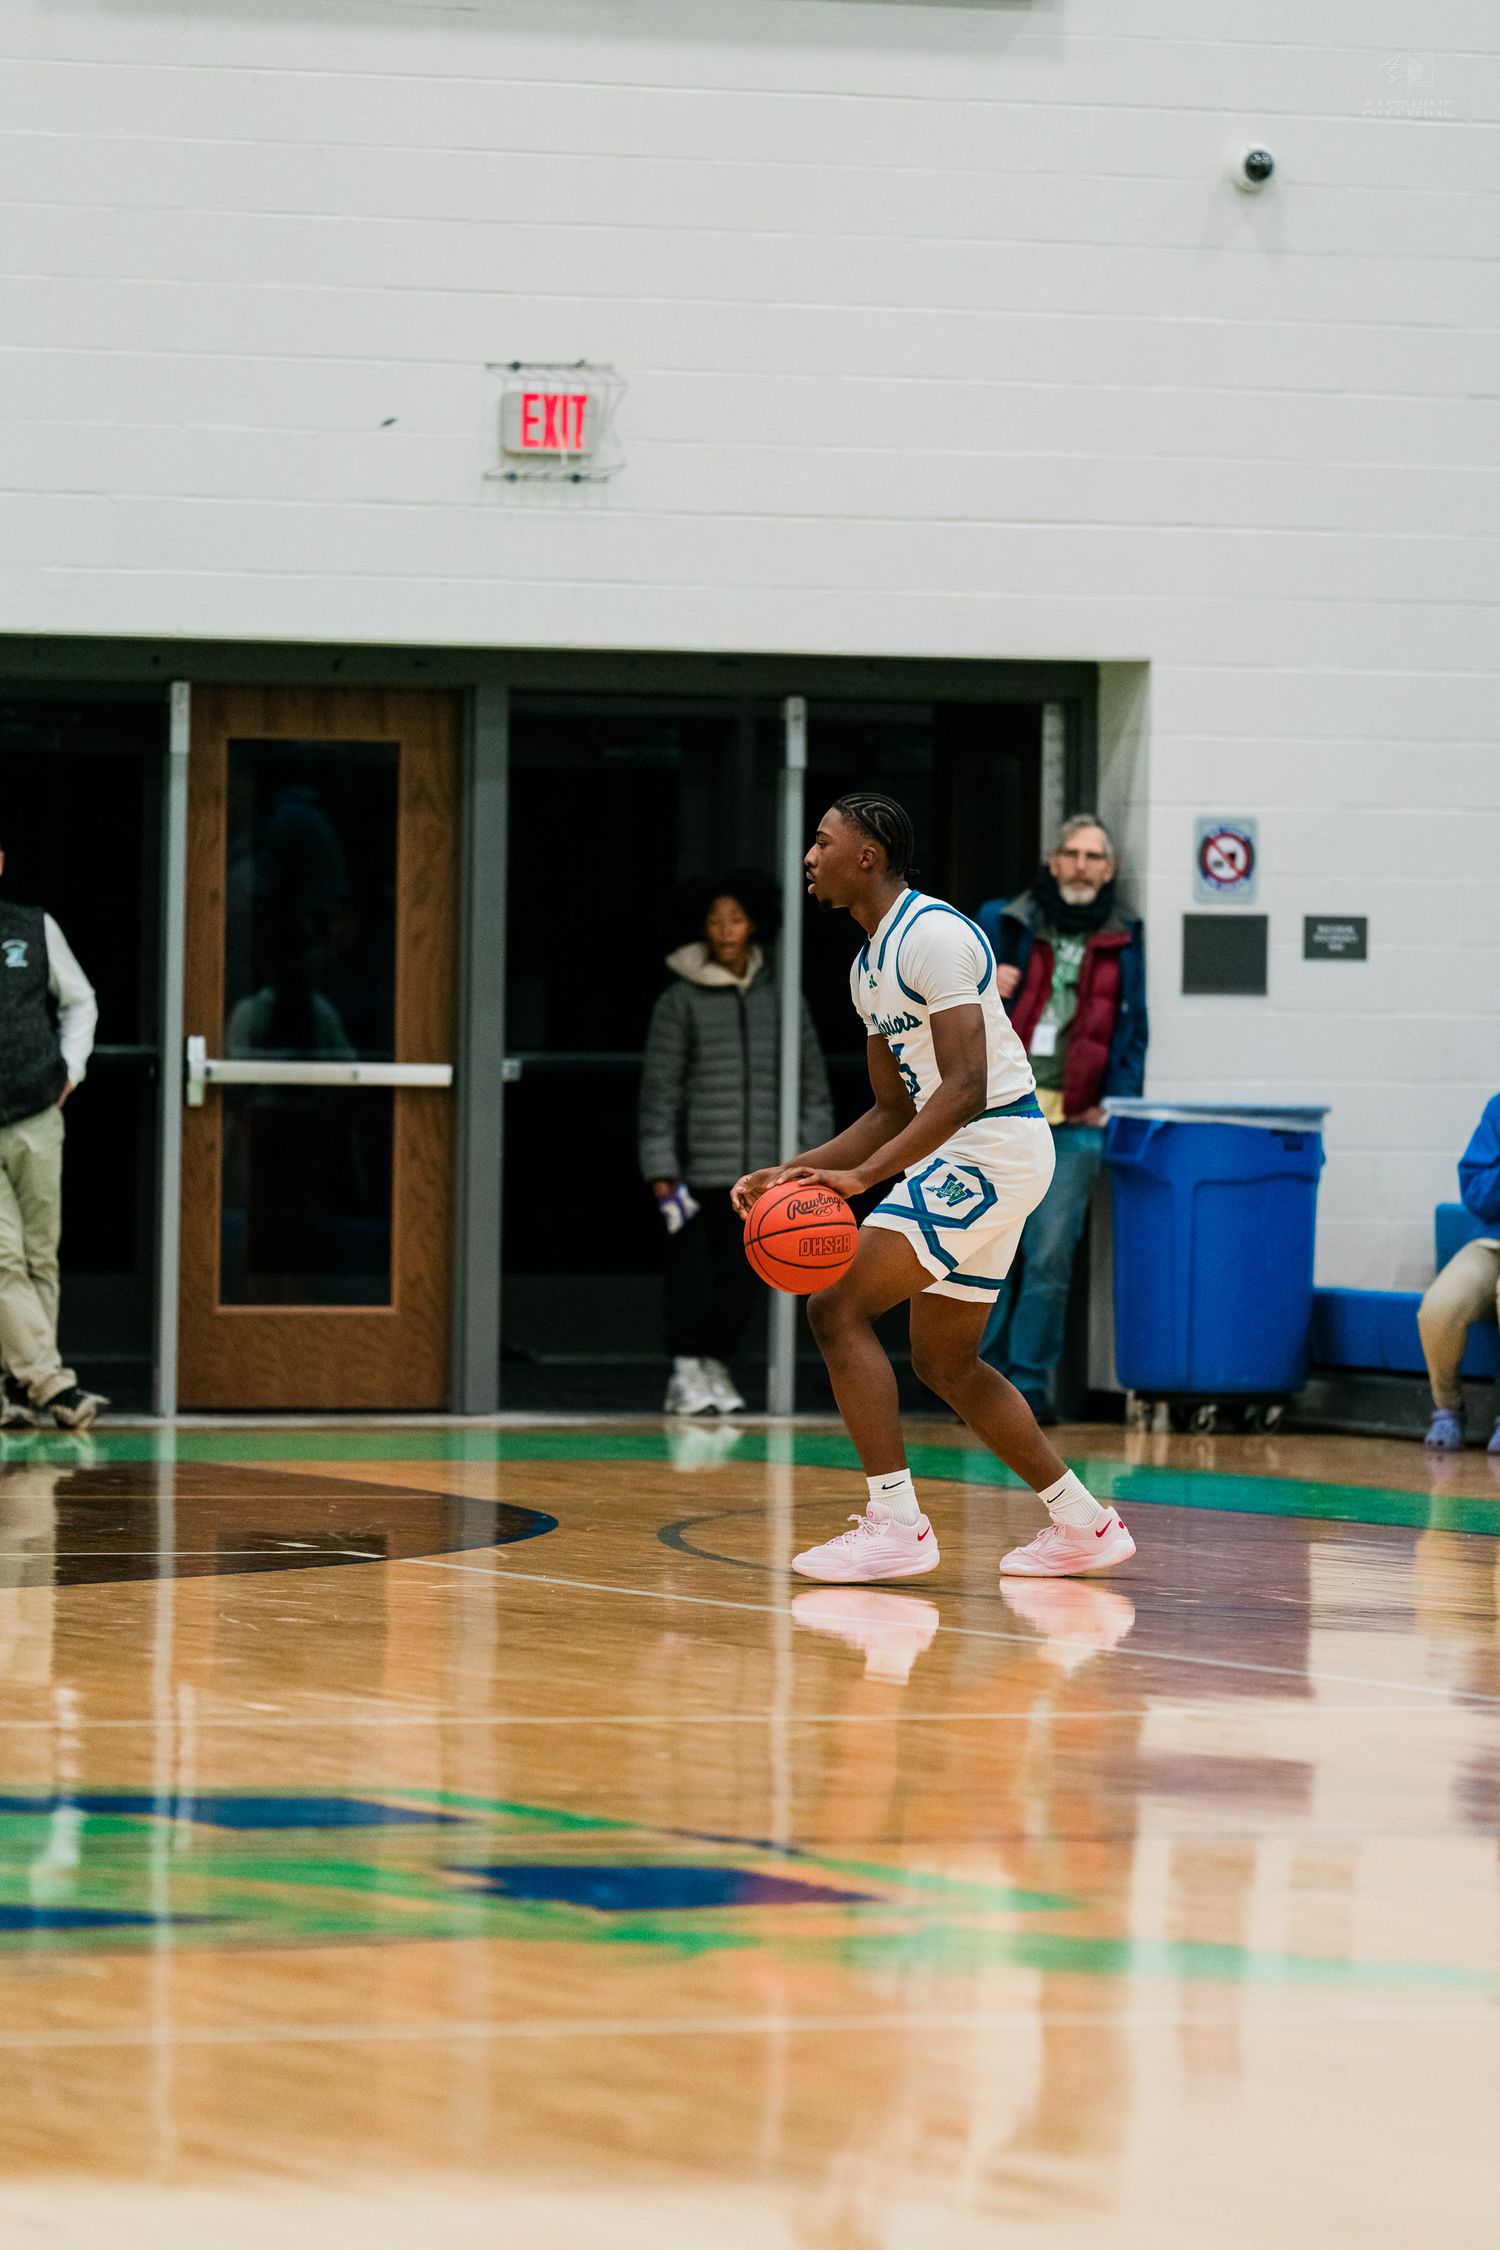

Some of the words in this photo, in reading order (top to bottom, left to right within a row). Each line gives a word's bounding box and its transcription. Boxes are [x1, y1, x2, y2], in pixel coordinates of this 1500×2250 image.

[521, 393, 588, 449] EXIT
[787, 1193, 844, 1220] Rawling
[799, 1233, 852, 1257] OHSAA
